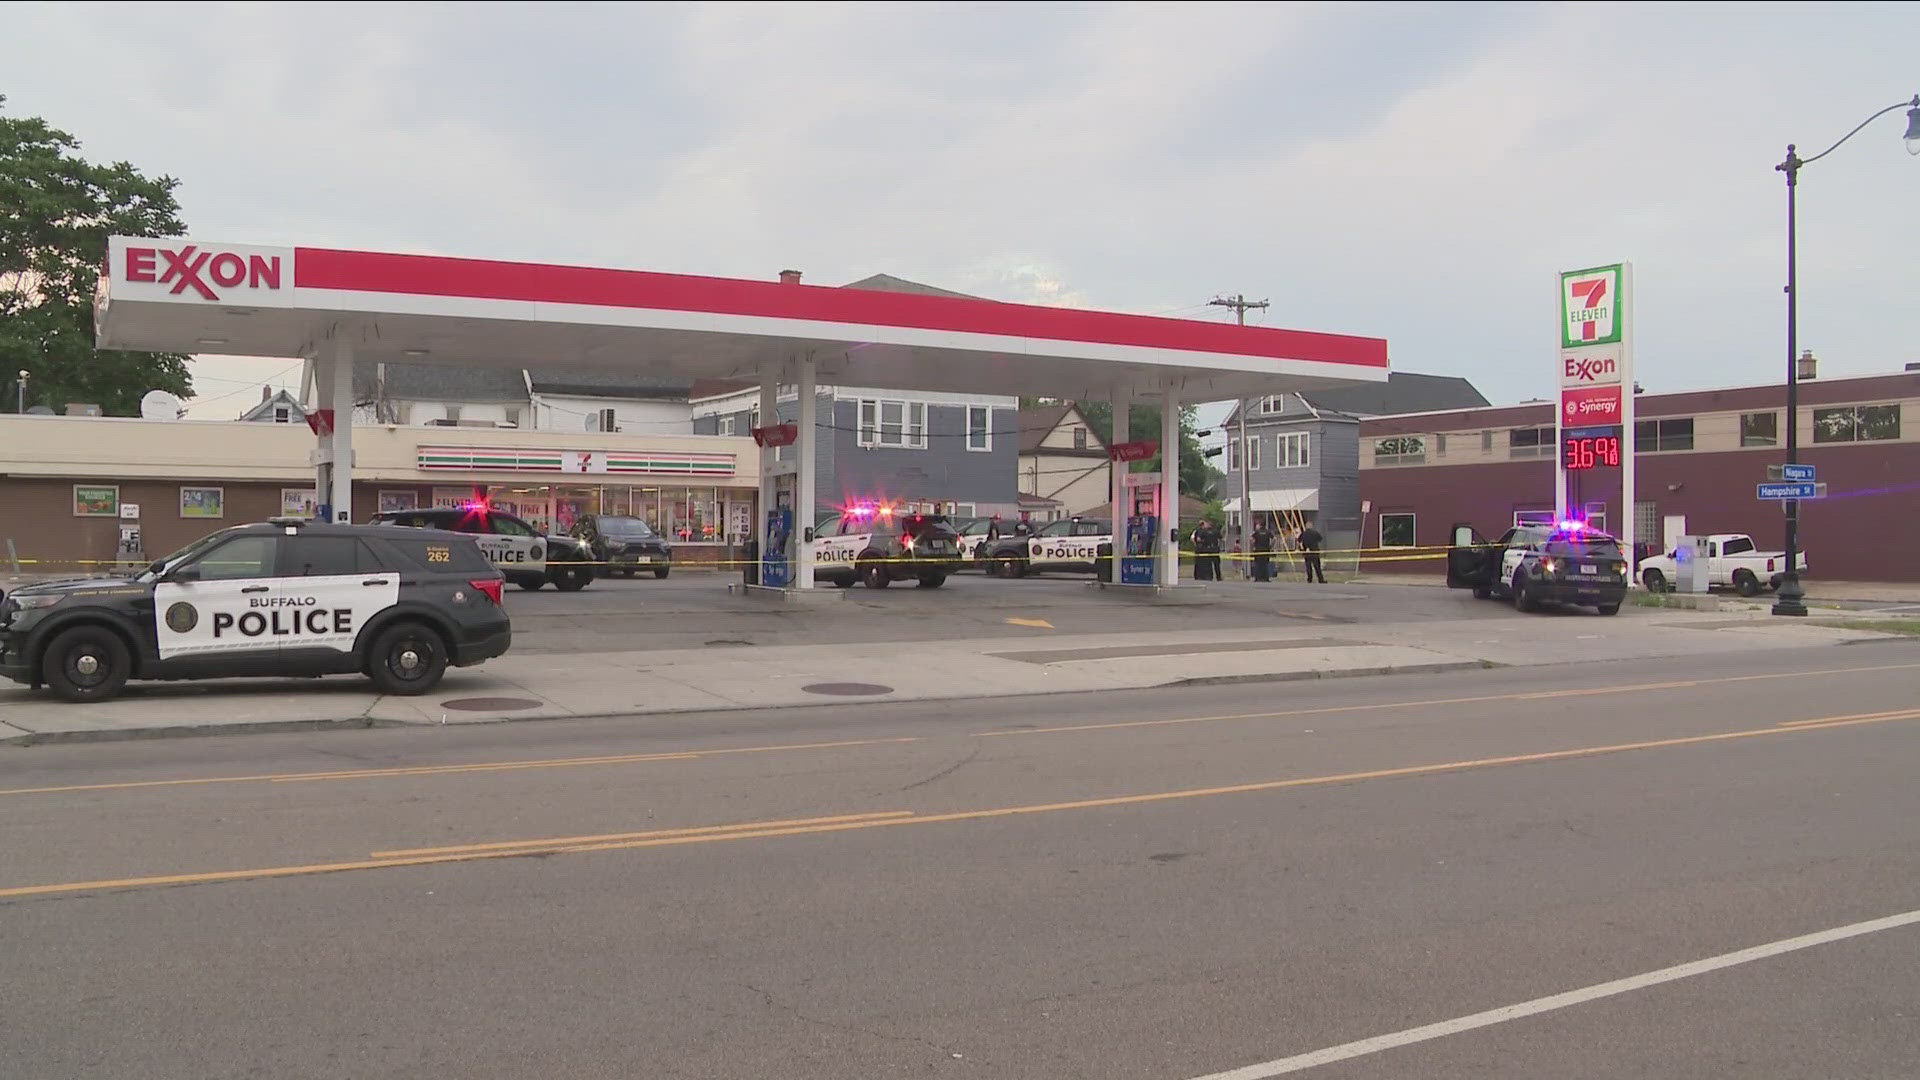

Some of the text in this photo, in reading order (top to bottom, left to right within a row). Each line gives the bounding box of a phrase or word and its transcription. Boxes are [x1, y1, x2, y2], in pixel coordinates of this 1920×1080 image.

[126, 245, 280, 300] EXXON
[1571, 306, 1607, 323] ELEVEN
[1572, 278, 1606, 340] 7
[1565, 358, 1615, 381] Exxon
[1579, 401, 1617, 414] Synergy
[1567, 437, 1607, 468] 3.69
[577, 453, 592, 472] 7
[1761, 486, 1811, 497] Hampshire St
[428, 551, 450, 562] 262
[480, 549, 525, 562] OLICE
[816, 549, 855, 562] POLICE
[1046, 547, 1094, 558] POLICE
[250, 596, 316, 608] BUFFALO
[213, 608, 352, 638] POLICE
